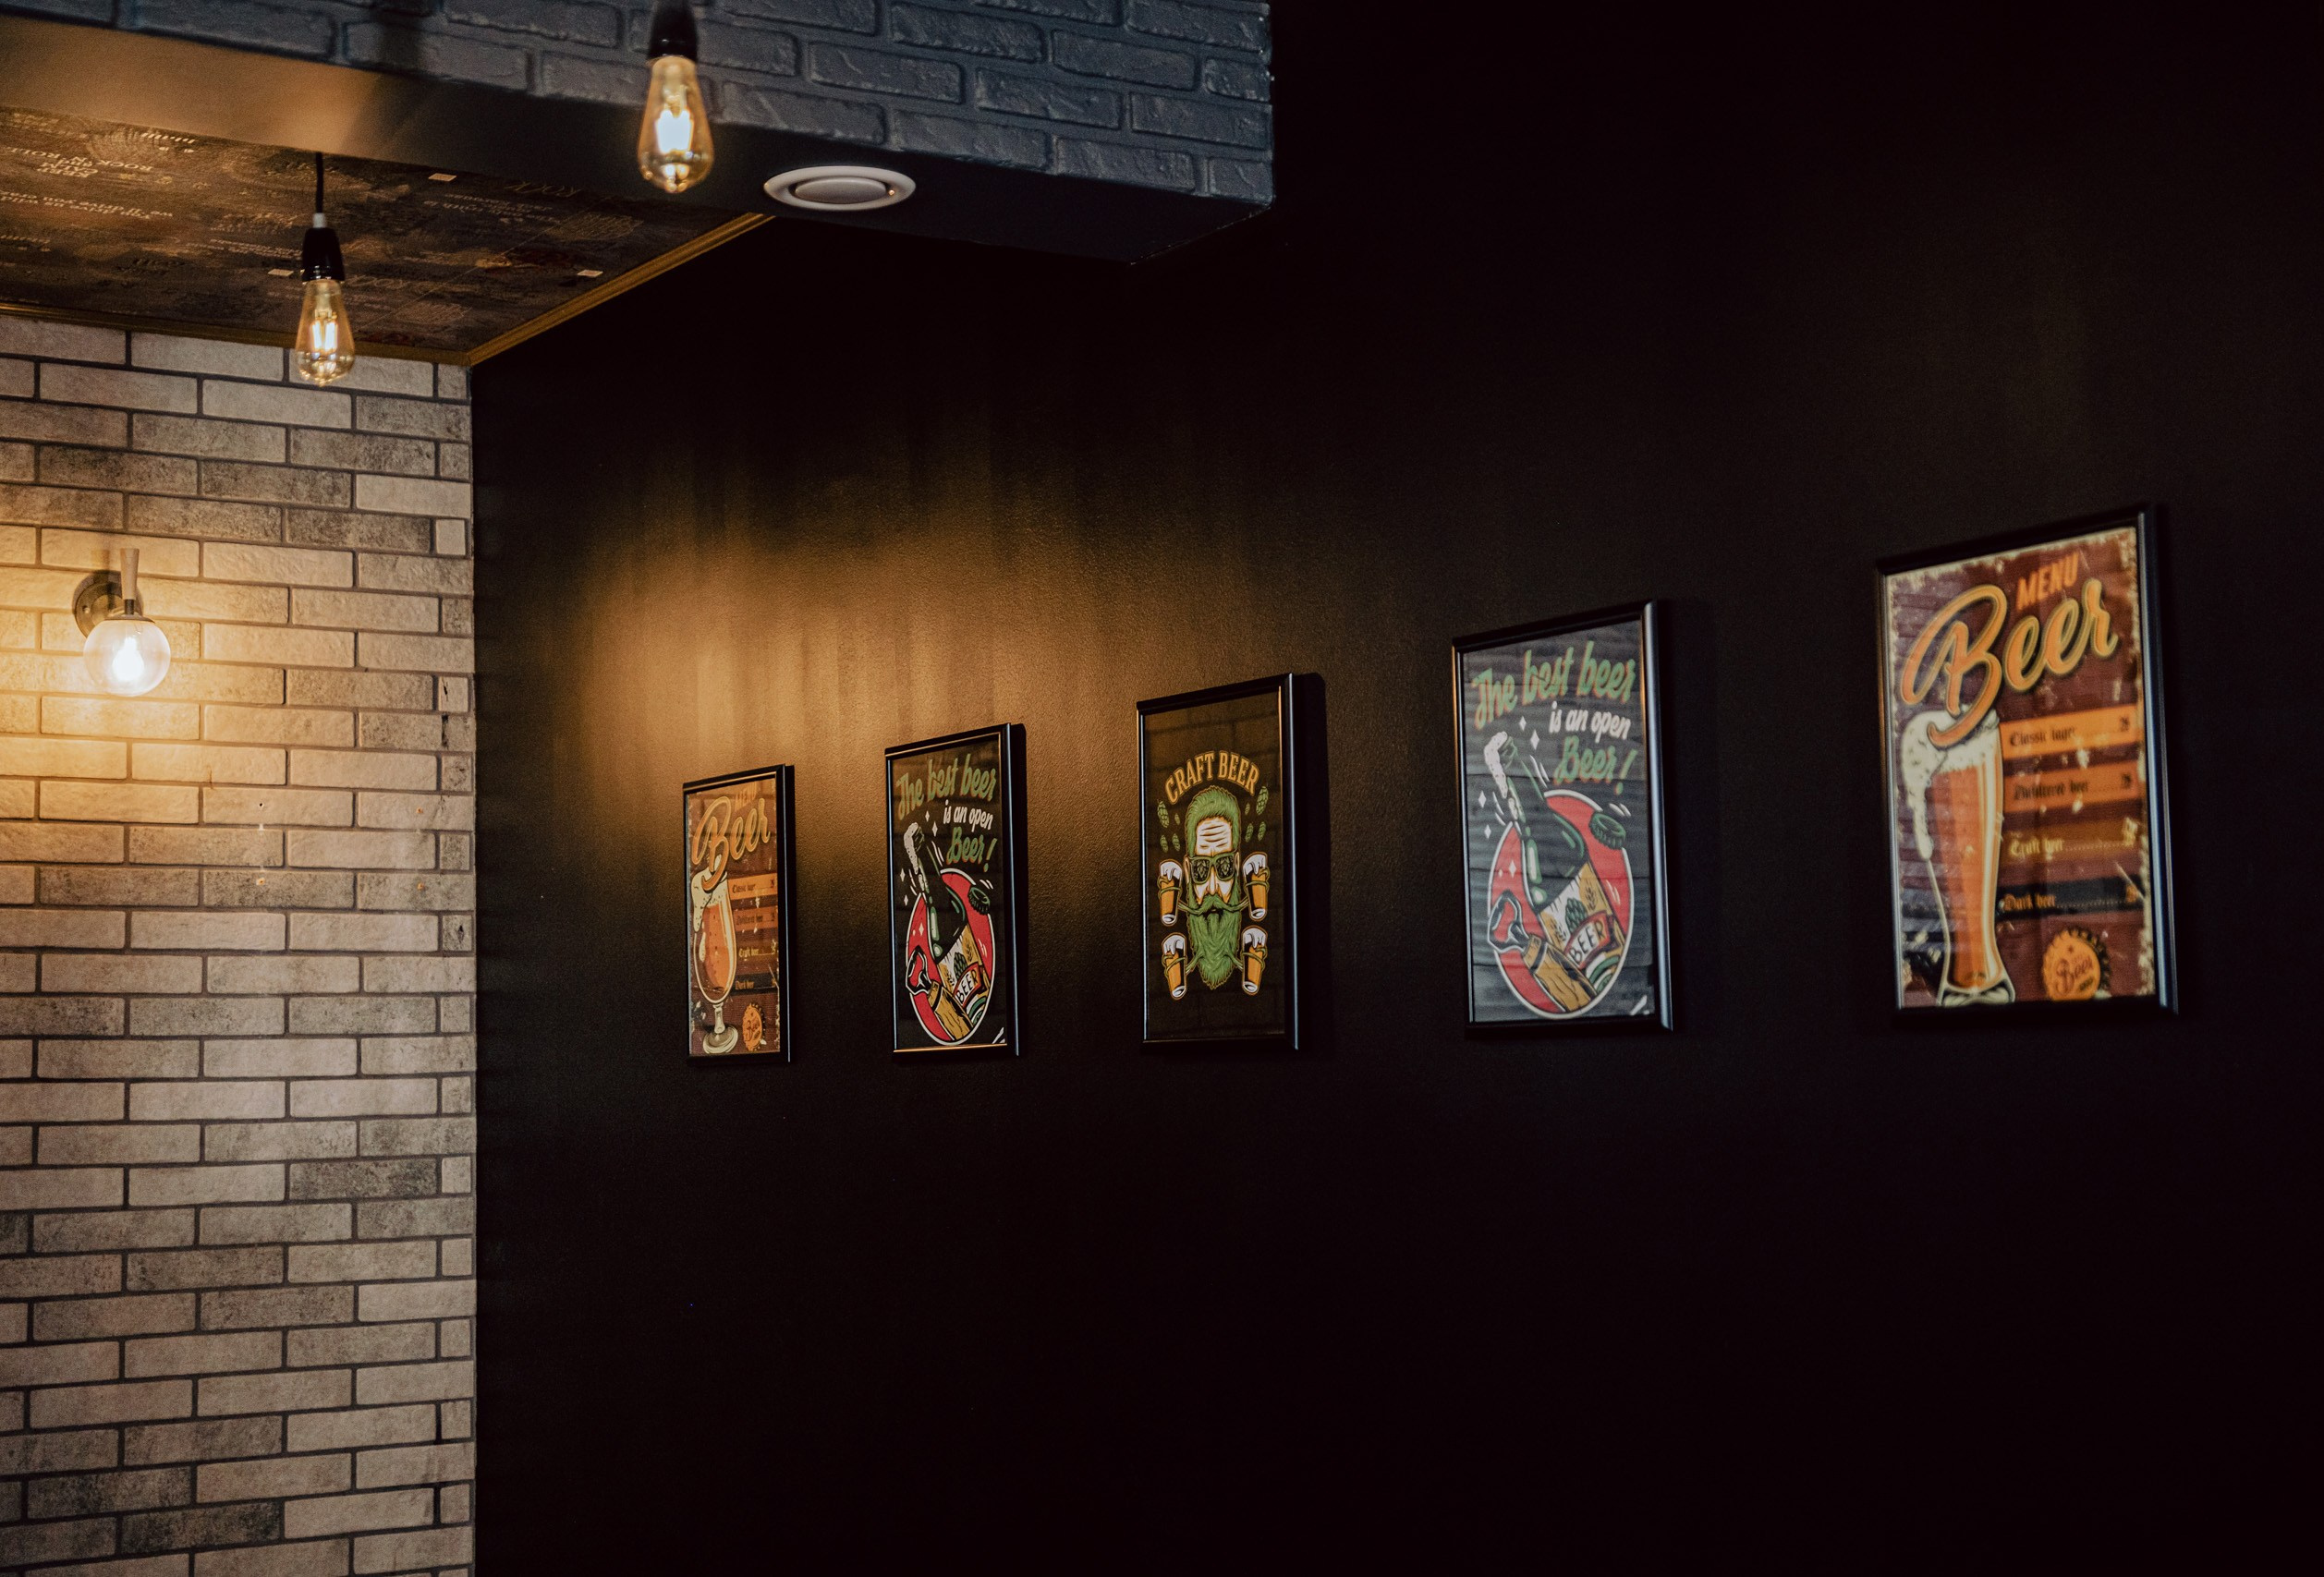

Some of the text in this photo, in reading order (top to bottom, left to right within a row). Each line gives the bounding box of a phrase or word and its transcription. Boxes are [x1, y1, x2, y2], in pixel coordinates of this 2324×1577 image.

[2014, 553, 2080, 612] MENU
[1470, 640, 1637, 731] The best beer
[1902, 578, 2119, 747] Beer
[1549, 700, 1632, 744] is an open
[895, 753, 997, 821] The best beer
[1164, 749, 1260, 805] CRAFT BEER
[691, 795, 771, 892] Beer
[943, 799, 993, 832] is an open
[1568, 920, 1606, 964] BEER
[955, 969, 979, 1003] BEER
